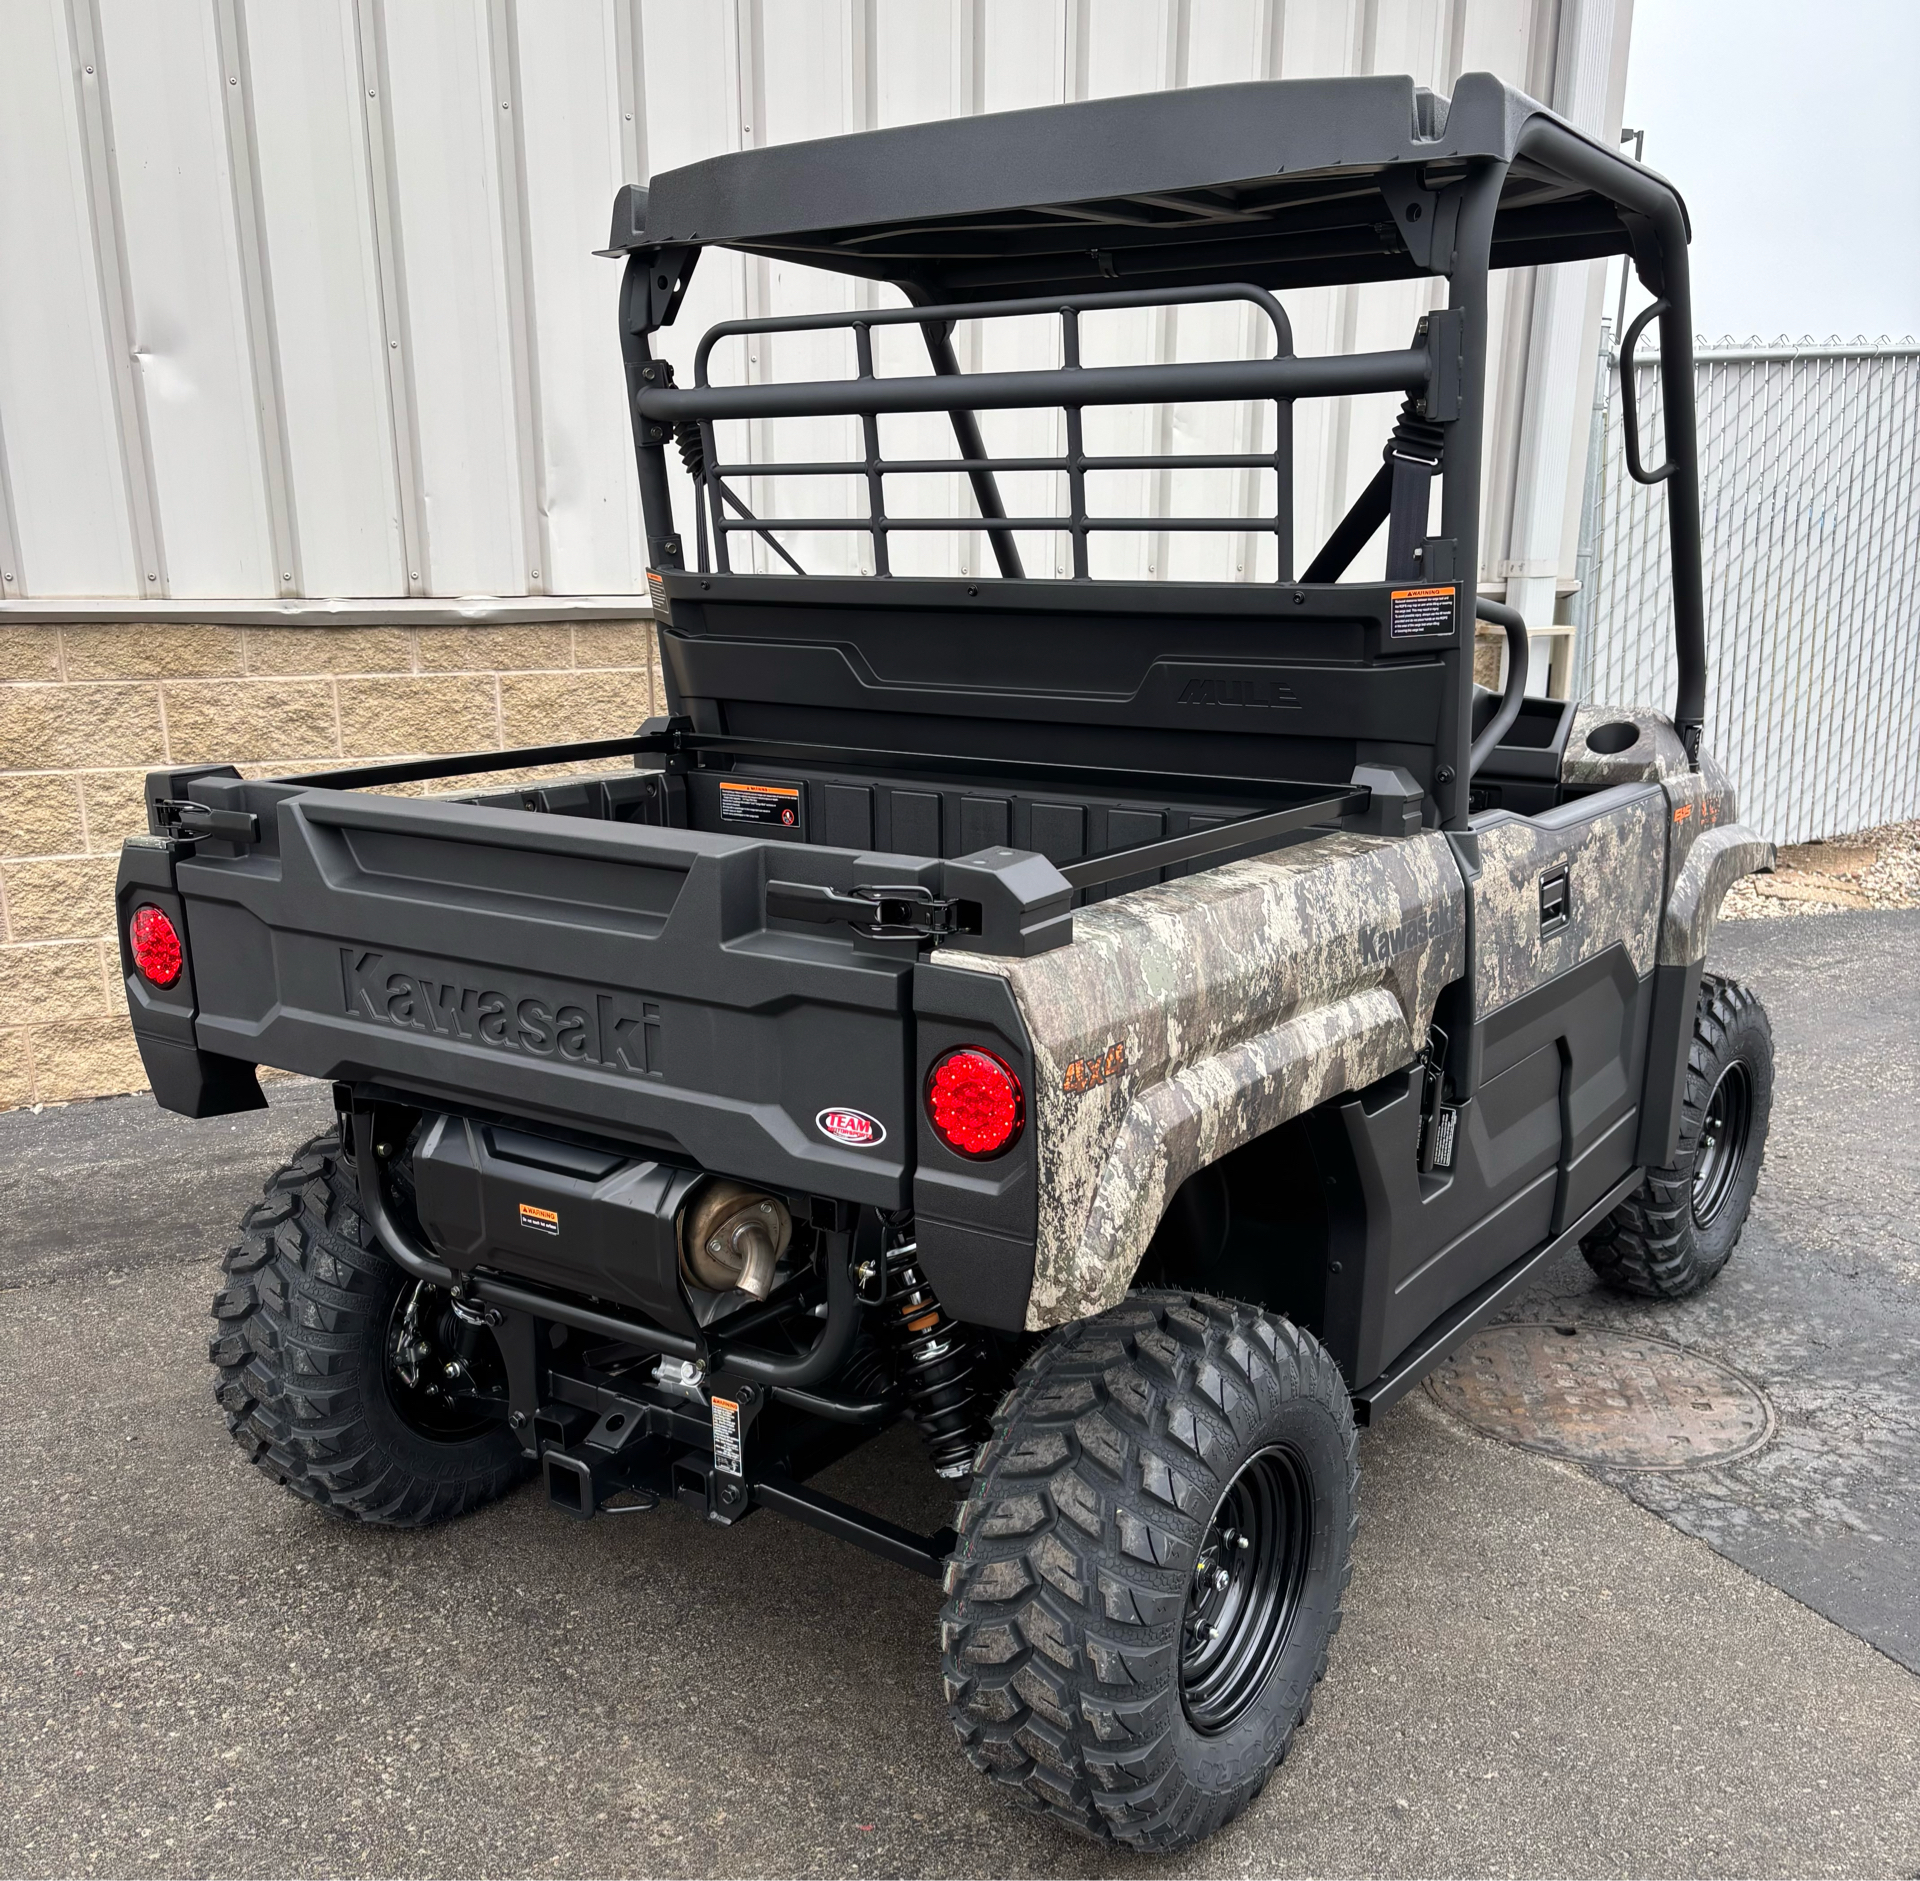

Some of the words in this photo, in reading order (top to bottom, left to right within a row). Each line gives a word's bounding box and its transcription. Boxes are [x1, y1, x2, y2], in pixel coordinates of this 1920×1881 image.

[1177, 678, 1302, 709] MULE
[1360, 899, 1455, 966] Kawasaki
[339, 947, 663, 1077] Kawasaki
[1062, 1040, 1129, 1095] 4x4
[828, 1113, 871, 1133] TEAM
[527, 1206, 555, 1220] WARNING
